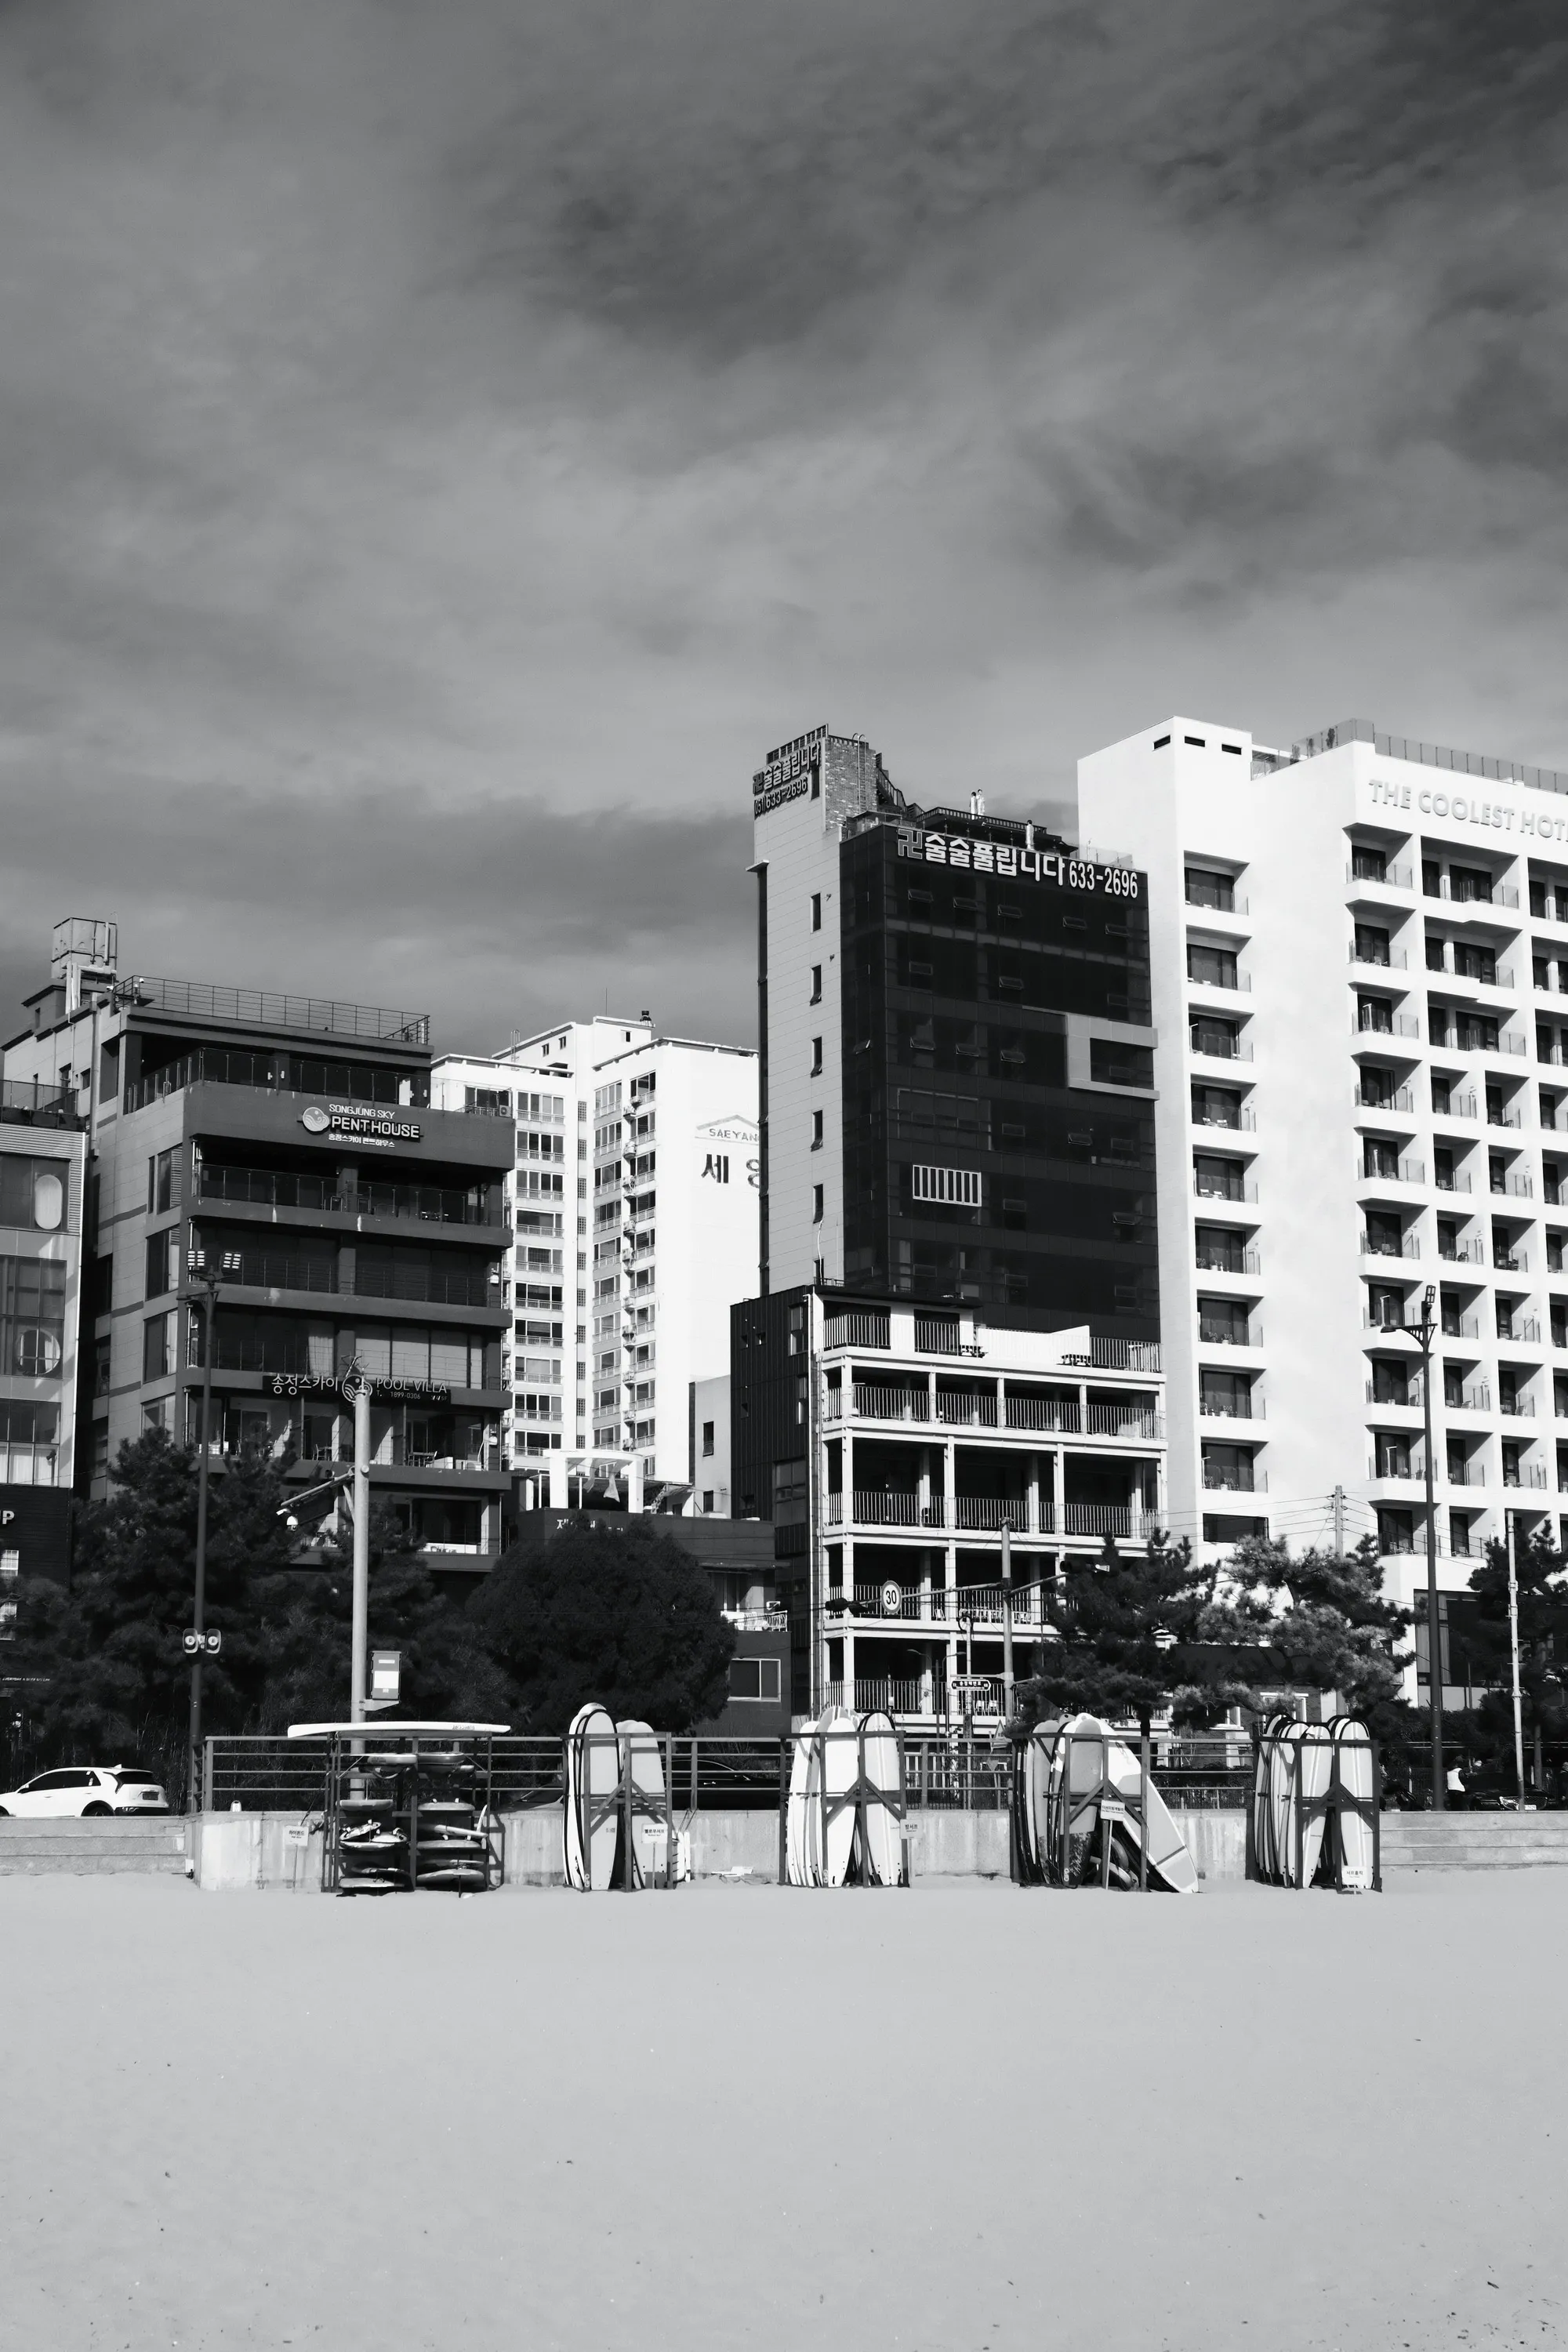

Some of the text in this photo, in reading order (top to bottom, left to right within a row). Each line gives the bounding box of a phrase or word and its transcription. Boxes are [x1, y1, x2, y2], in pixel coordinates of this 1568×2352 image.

[764, 740, 820, 790] 술술풀립니다
[1369, 779, 1568, 843] THE COOLEST HOT
[924, 833, 1138, 898] 술술풀립니다 633-2696
[328, 1104, 395, 1120] SONGJUNG SKY
[332, 1116, 419, 1138] PENTHOUSE
[709, 1128, 760, 1142] SAEYAN
[271, 1374, 338, 1396] 송정스카이
[376, 1377, 447, 1394] POOL VILLA
[390, 1391, 421, 1399] 1899-0306
[886, 1589, 897, 1605] 30
